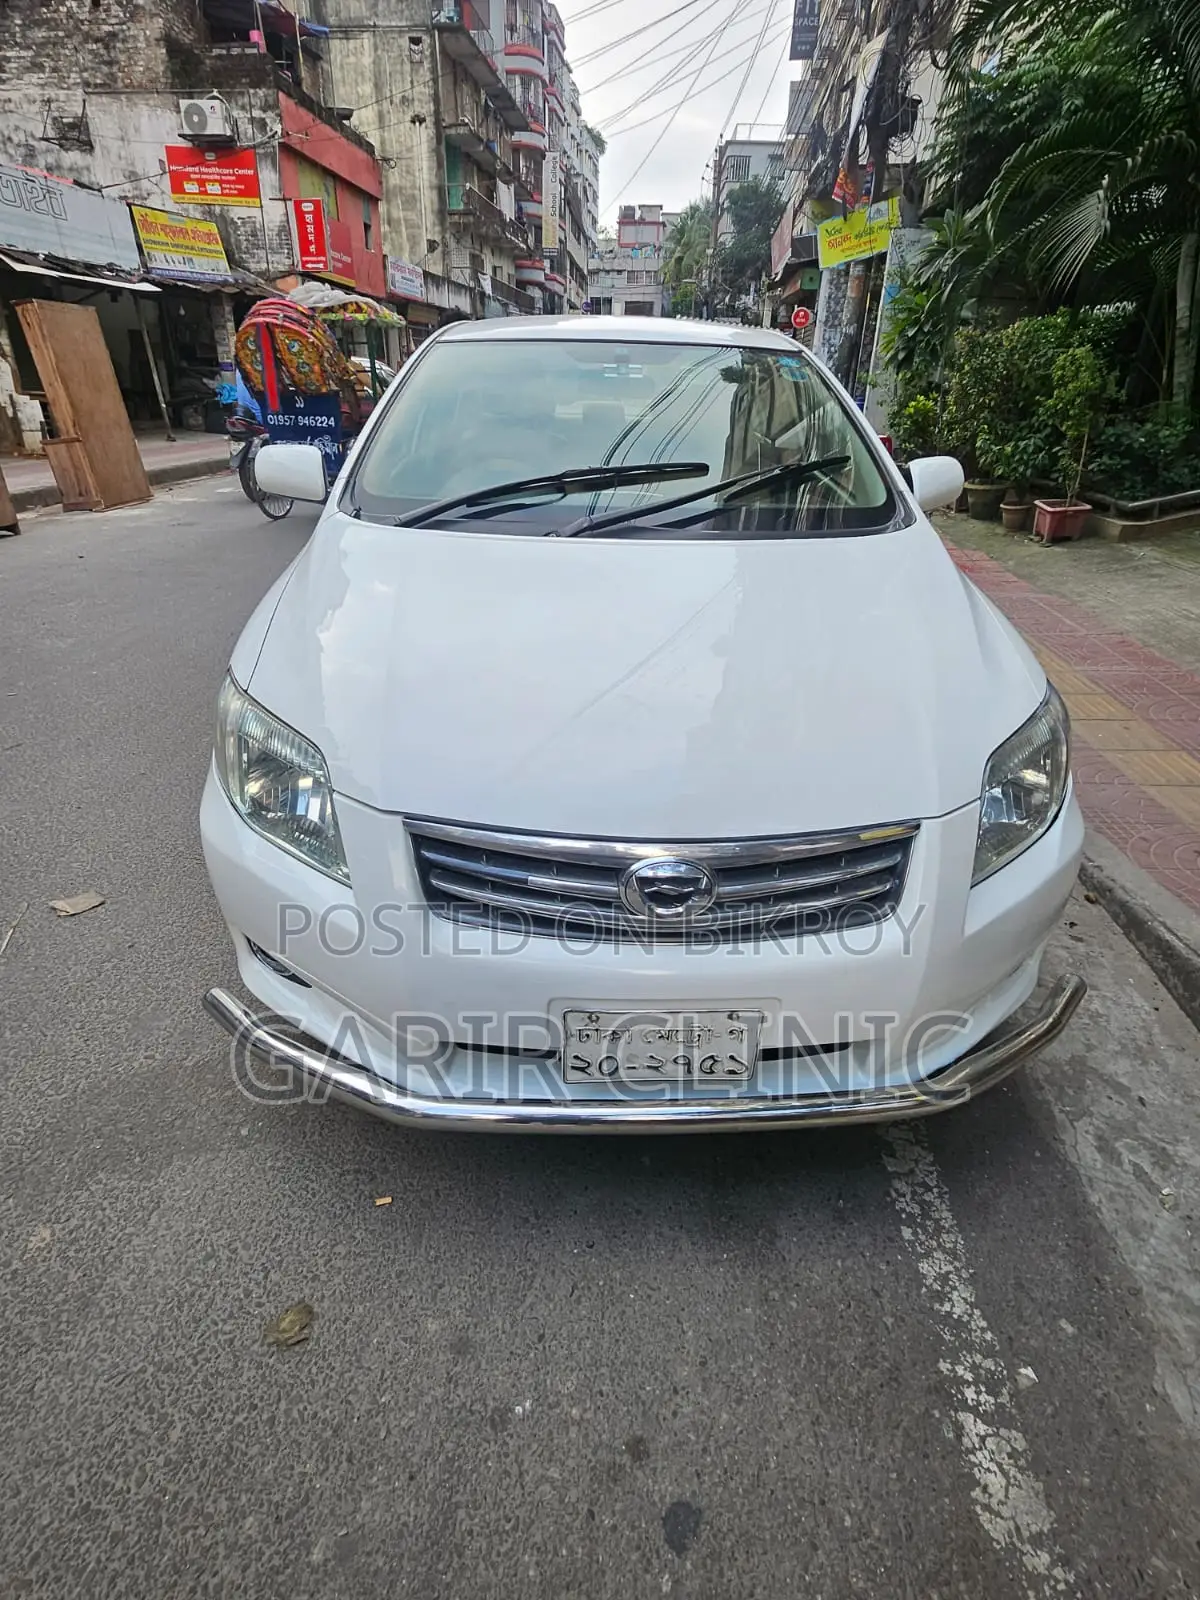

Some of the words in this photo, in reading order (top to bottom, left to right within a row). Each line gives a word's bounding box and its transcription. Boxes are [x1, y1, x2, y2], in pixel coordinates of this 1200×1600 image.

[795, 17, 819, 26] SPACE
[200, 166, 233, 174] Healthcare
[267, 414, 295, 426] 01957
[298, 415, 335, 428] 946224
[575, 1027, 633, 1044] ঢাকা
